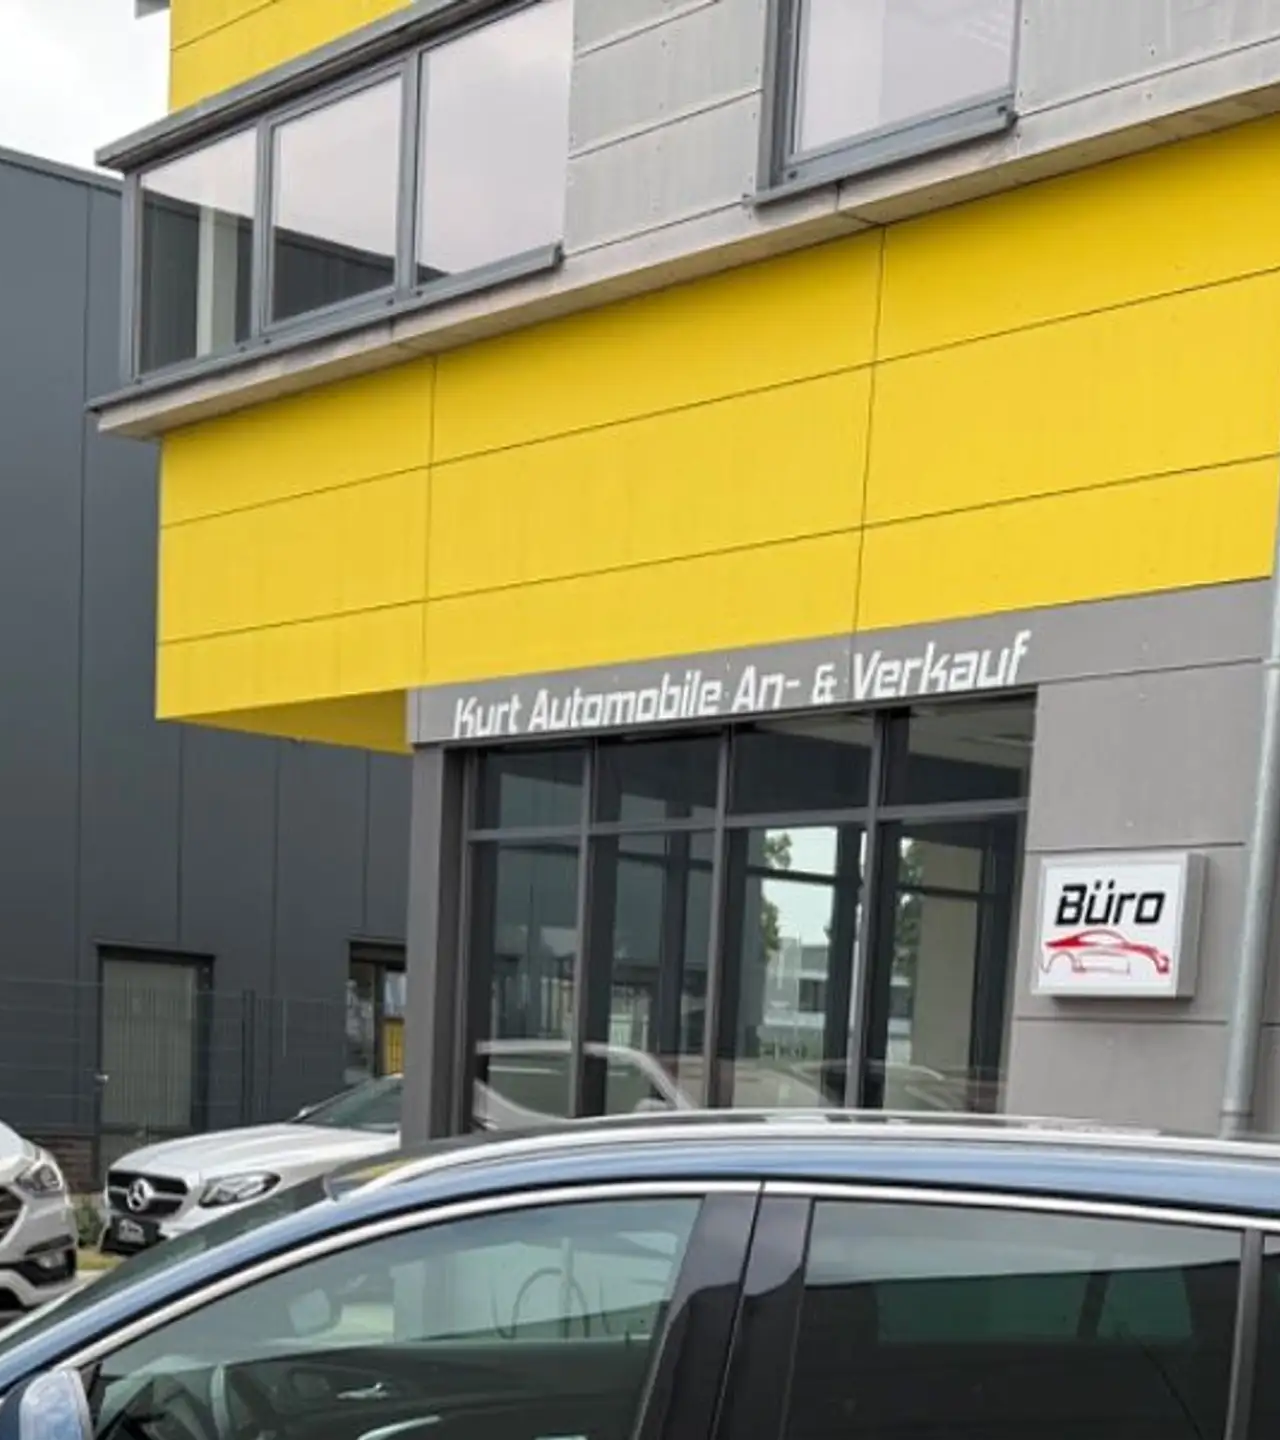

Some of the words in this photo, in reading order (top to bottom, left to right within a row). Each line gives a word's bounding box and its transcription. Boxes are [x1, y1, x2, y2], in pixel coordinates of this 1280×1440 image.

[454, 696, 521, 739] Kurt
[529, 670, 723, 733] Automobile
[730, 665, 800, 713] An-
[811, 664, 835, 704] &
[852, 629, 1031, 700] Verkauf
[1055, 879, 1165, 925] Büro
